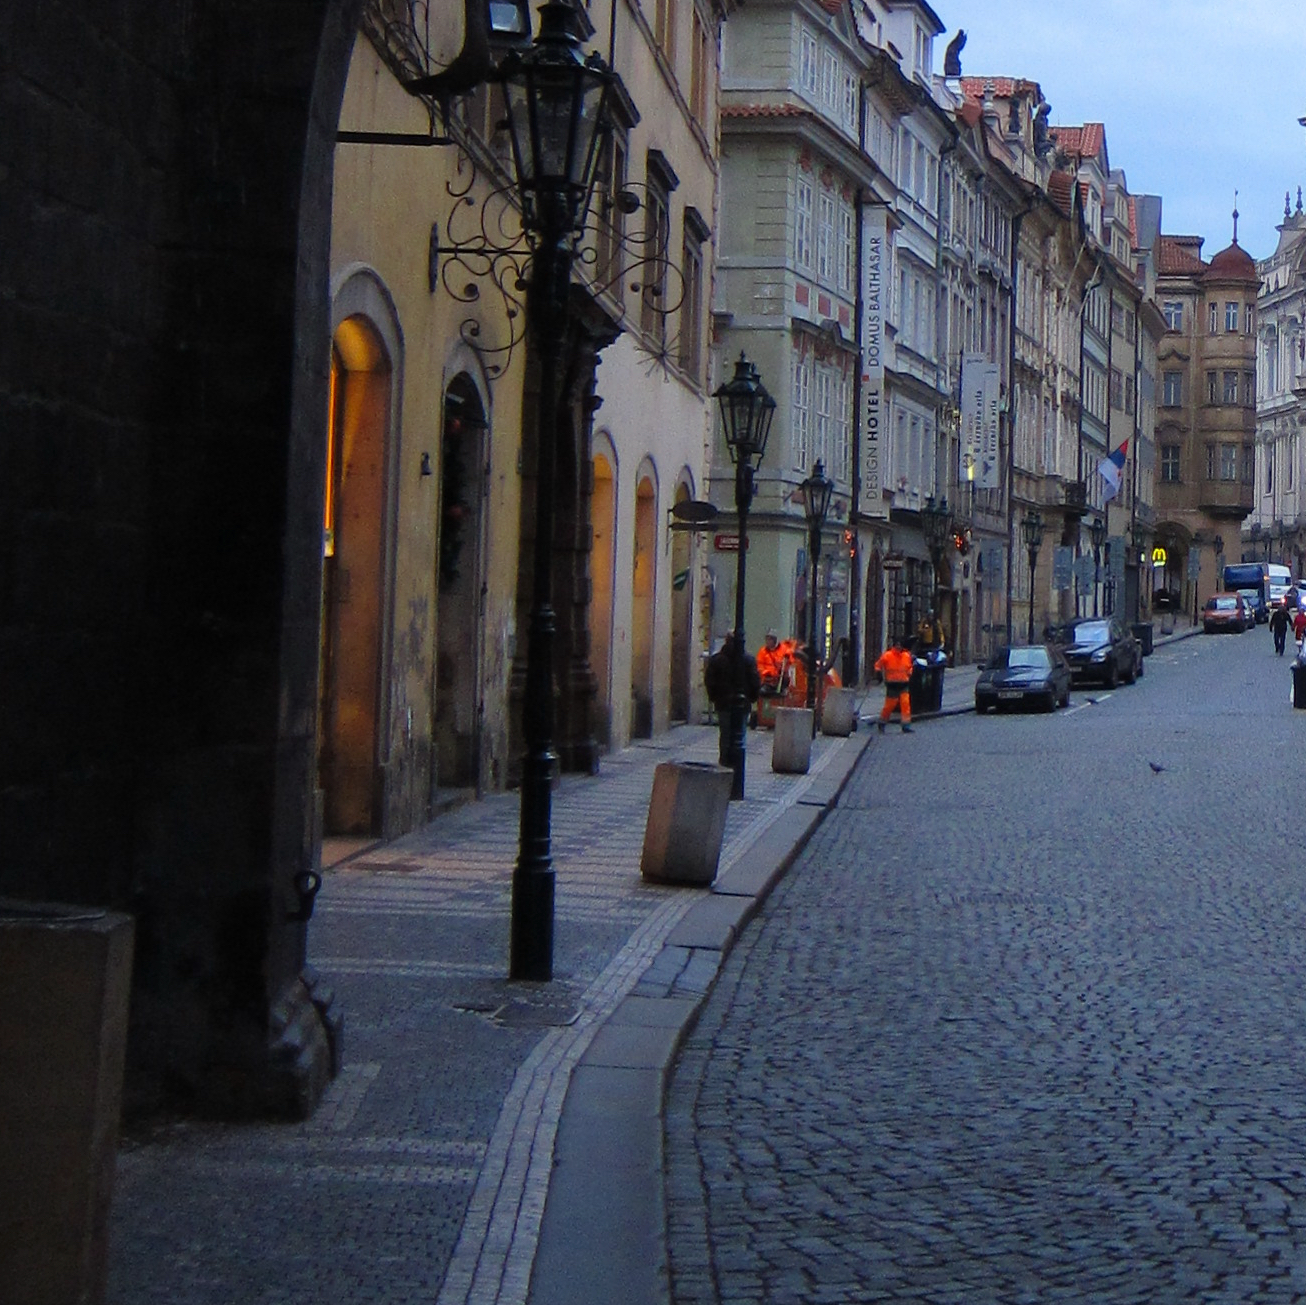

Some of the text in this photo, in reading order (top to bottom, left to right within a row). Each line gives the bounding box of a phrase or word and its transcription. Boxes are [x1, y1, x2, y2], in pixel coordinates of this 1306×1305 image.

[866, 237, 881, 500] DESIGN HOTEL DOMUS BALTHASAR
